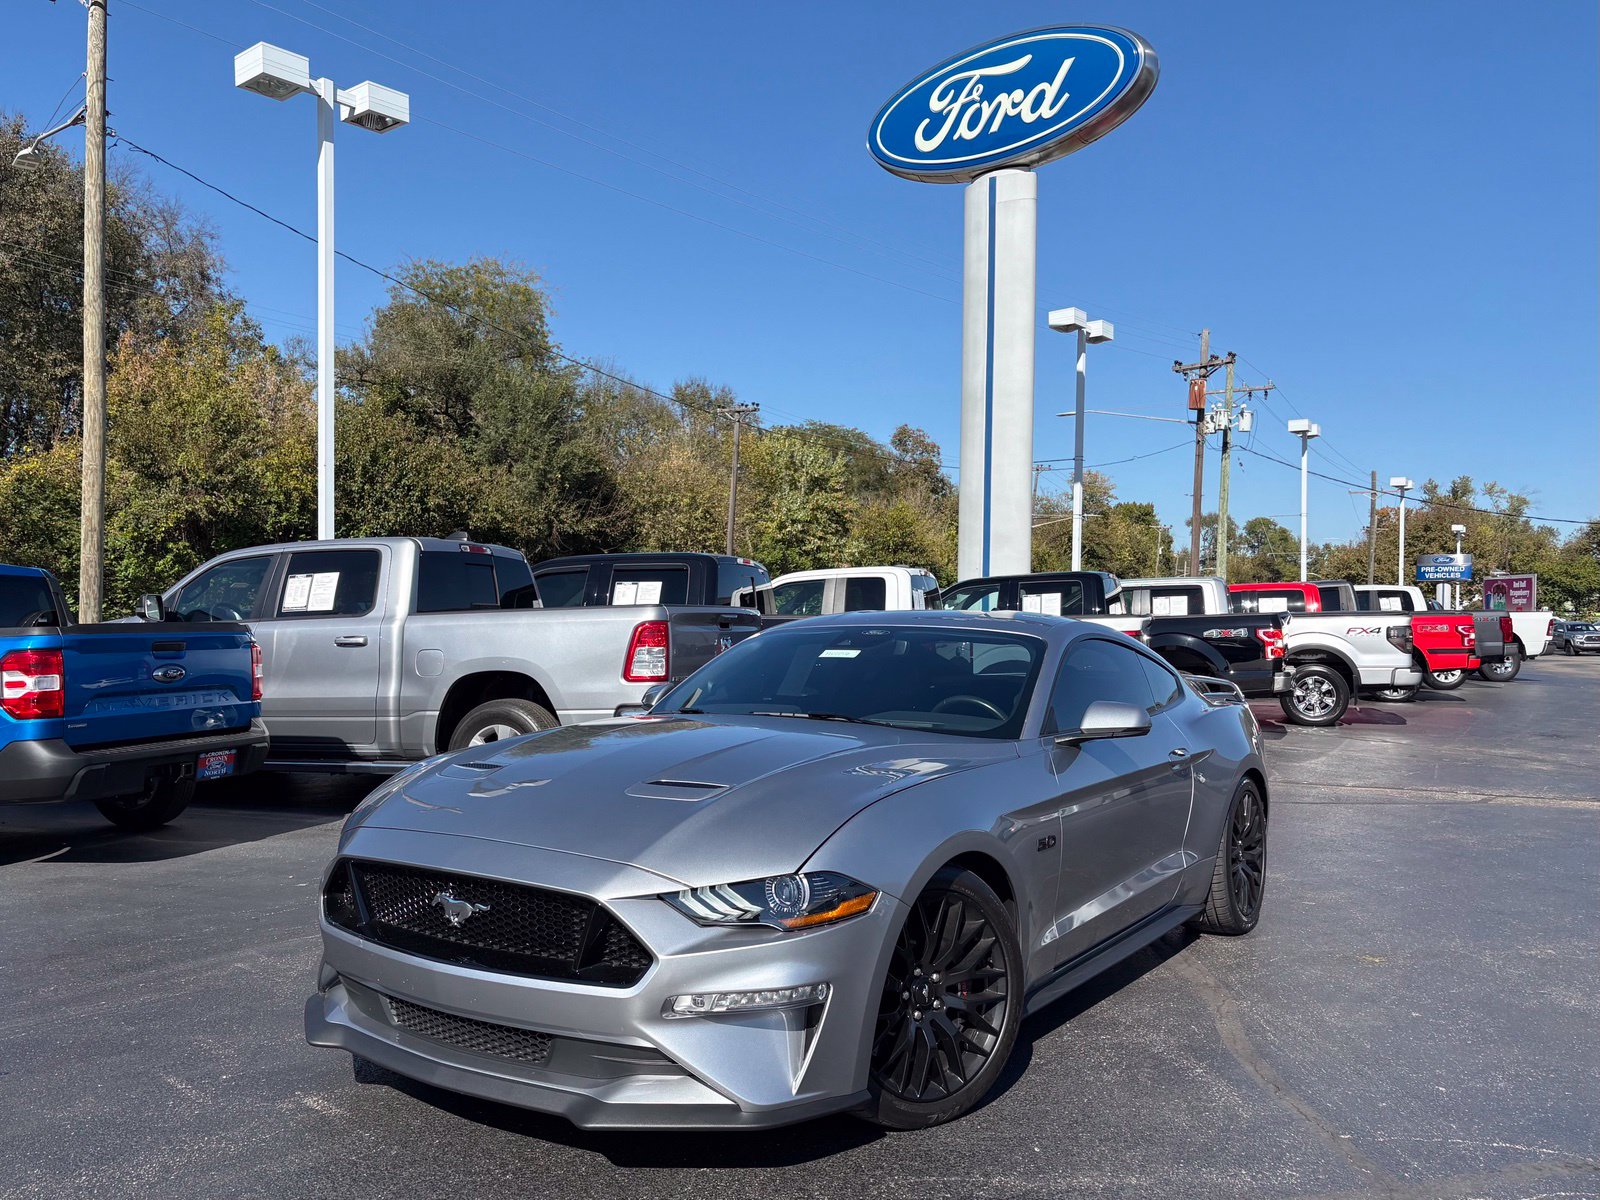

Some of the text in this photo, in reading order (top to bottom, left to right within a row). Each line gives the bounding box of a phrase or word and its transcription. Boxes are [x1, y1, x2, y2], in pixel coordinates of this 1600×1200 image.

[914, 53, 1076, 153] Ford
[1346, 626, 1382, 635] FX4
[1416, 624, 1449, 633] FX4
[95, 691, 229, 713] MAVERICK
[204, 767, 226, 777] NORTH
